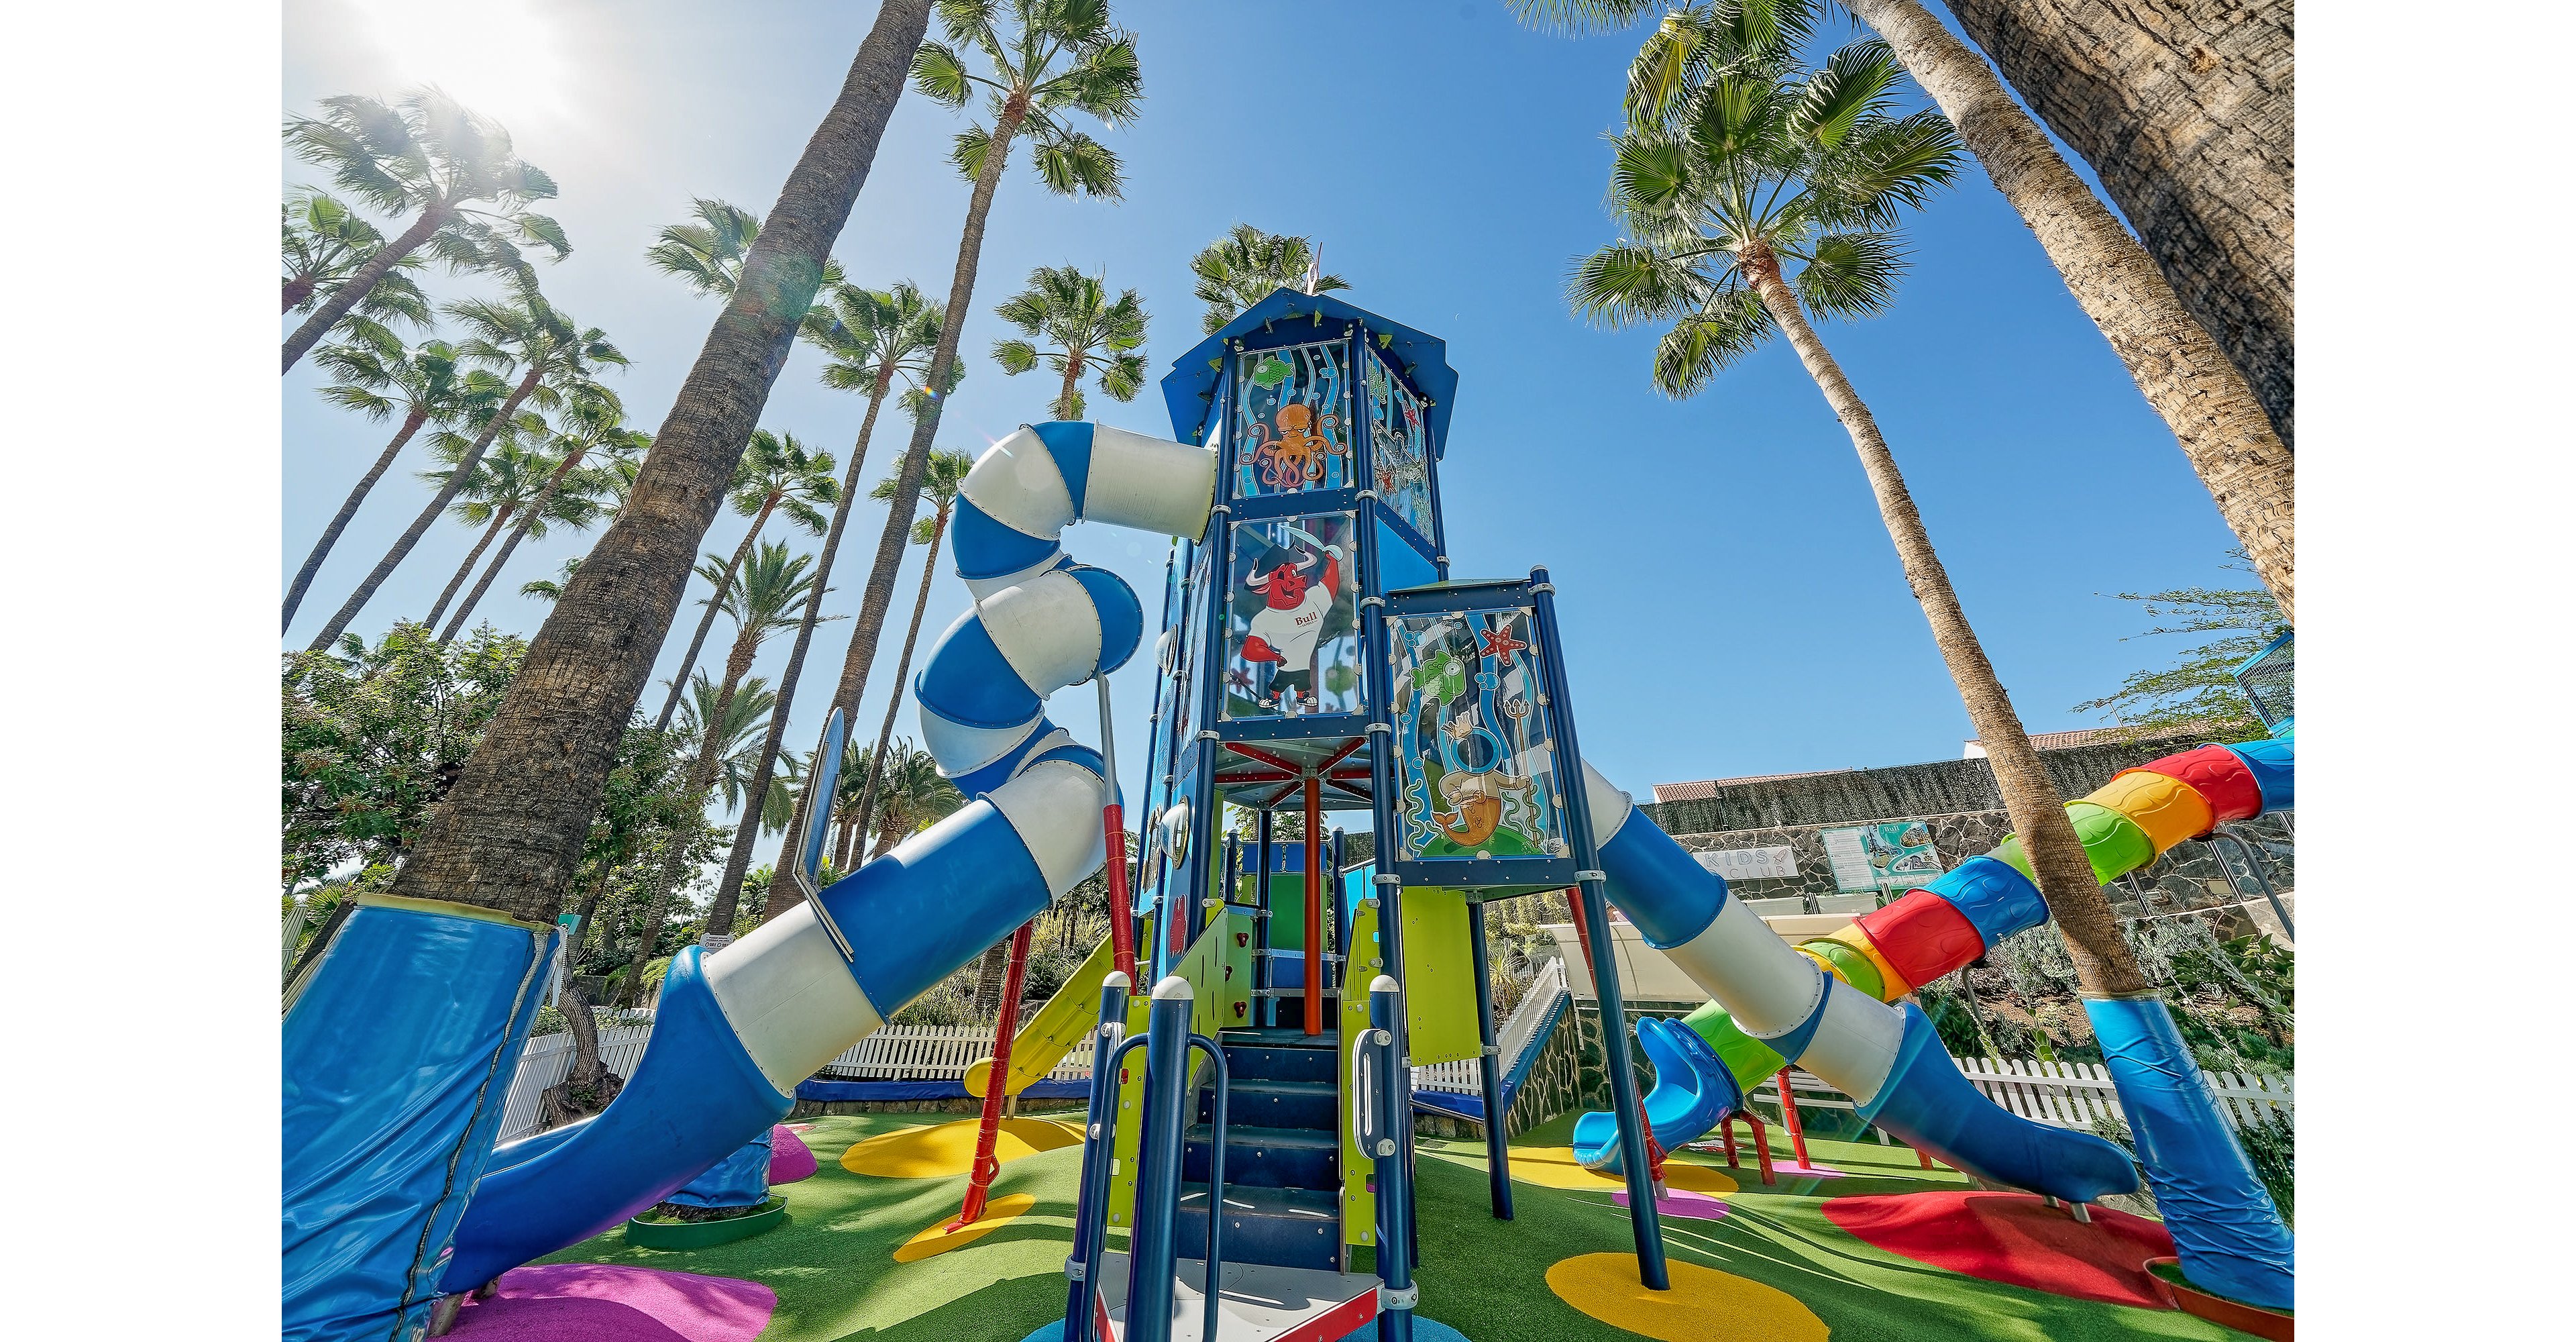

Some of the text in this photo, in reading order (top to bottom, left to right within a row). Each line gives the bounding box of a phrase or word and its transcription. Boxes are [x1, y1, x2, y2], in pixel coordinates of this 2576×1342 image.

[1295, 611, 1318, 625] Bull
[1704, 849, 1768, 867] KIDS
[1729, 866, 1786, 879] CLUB
